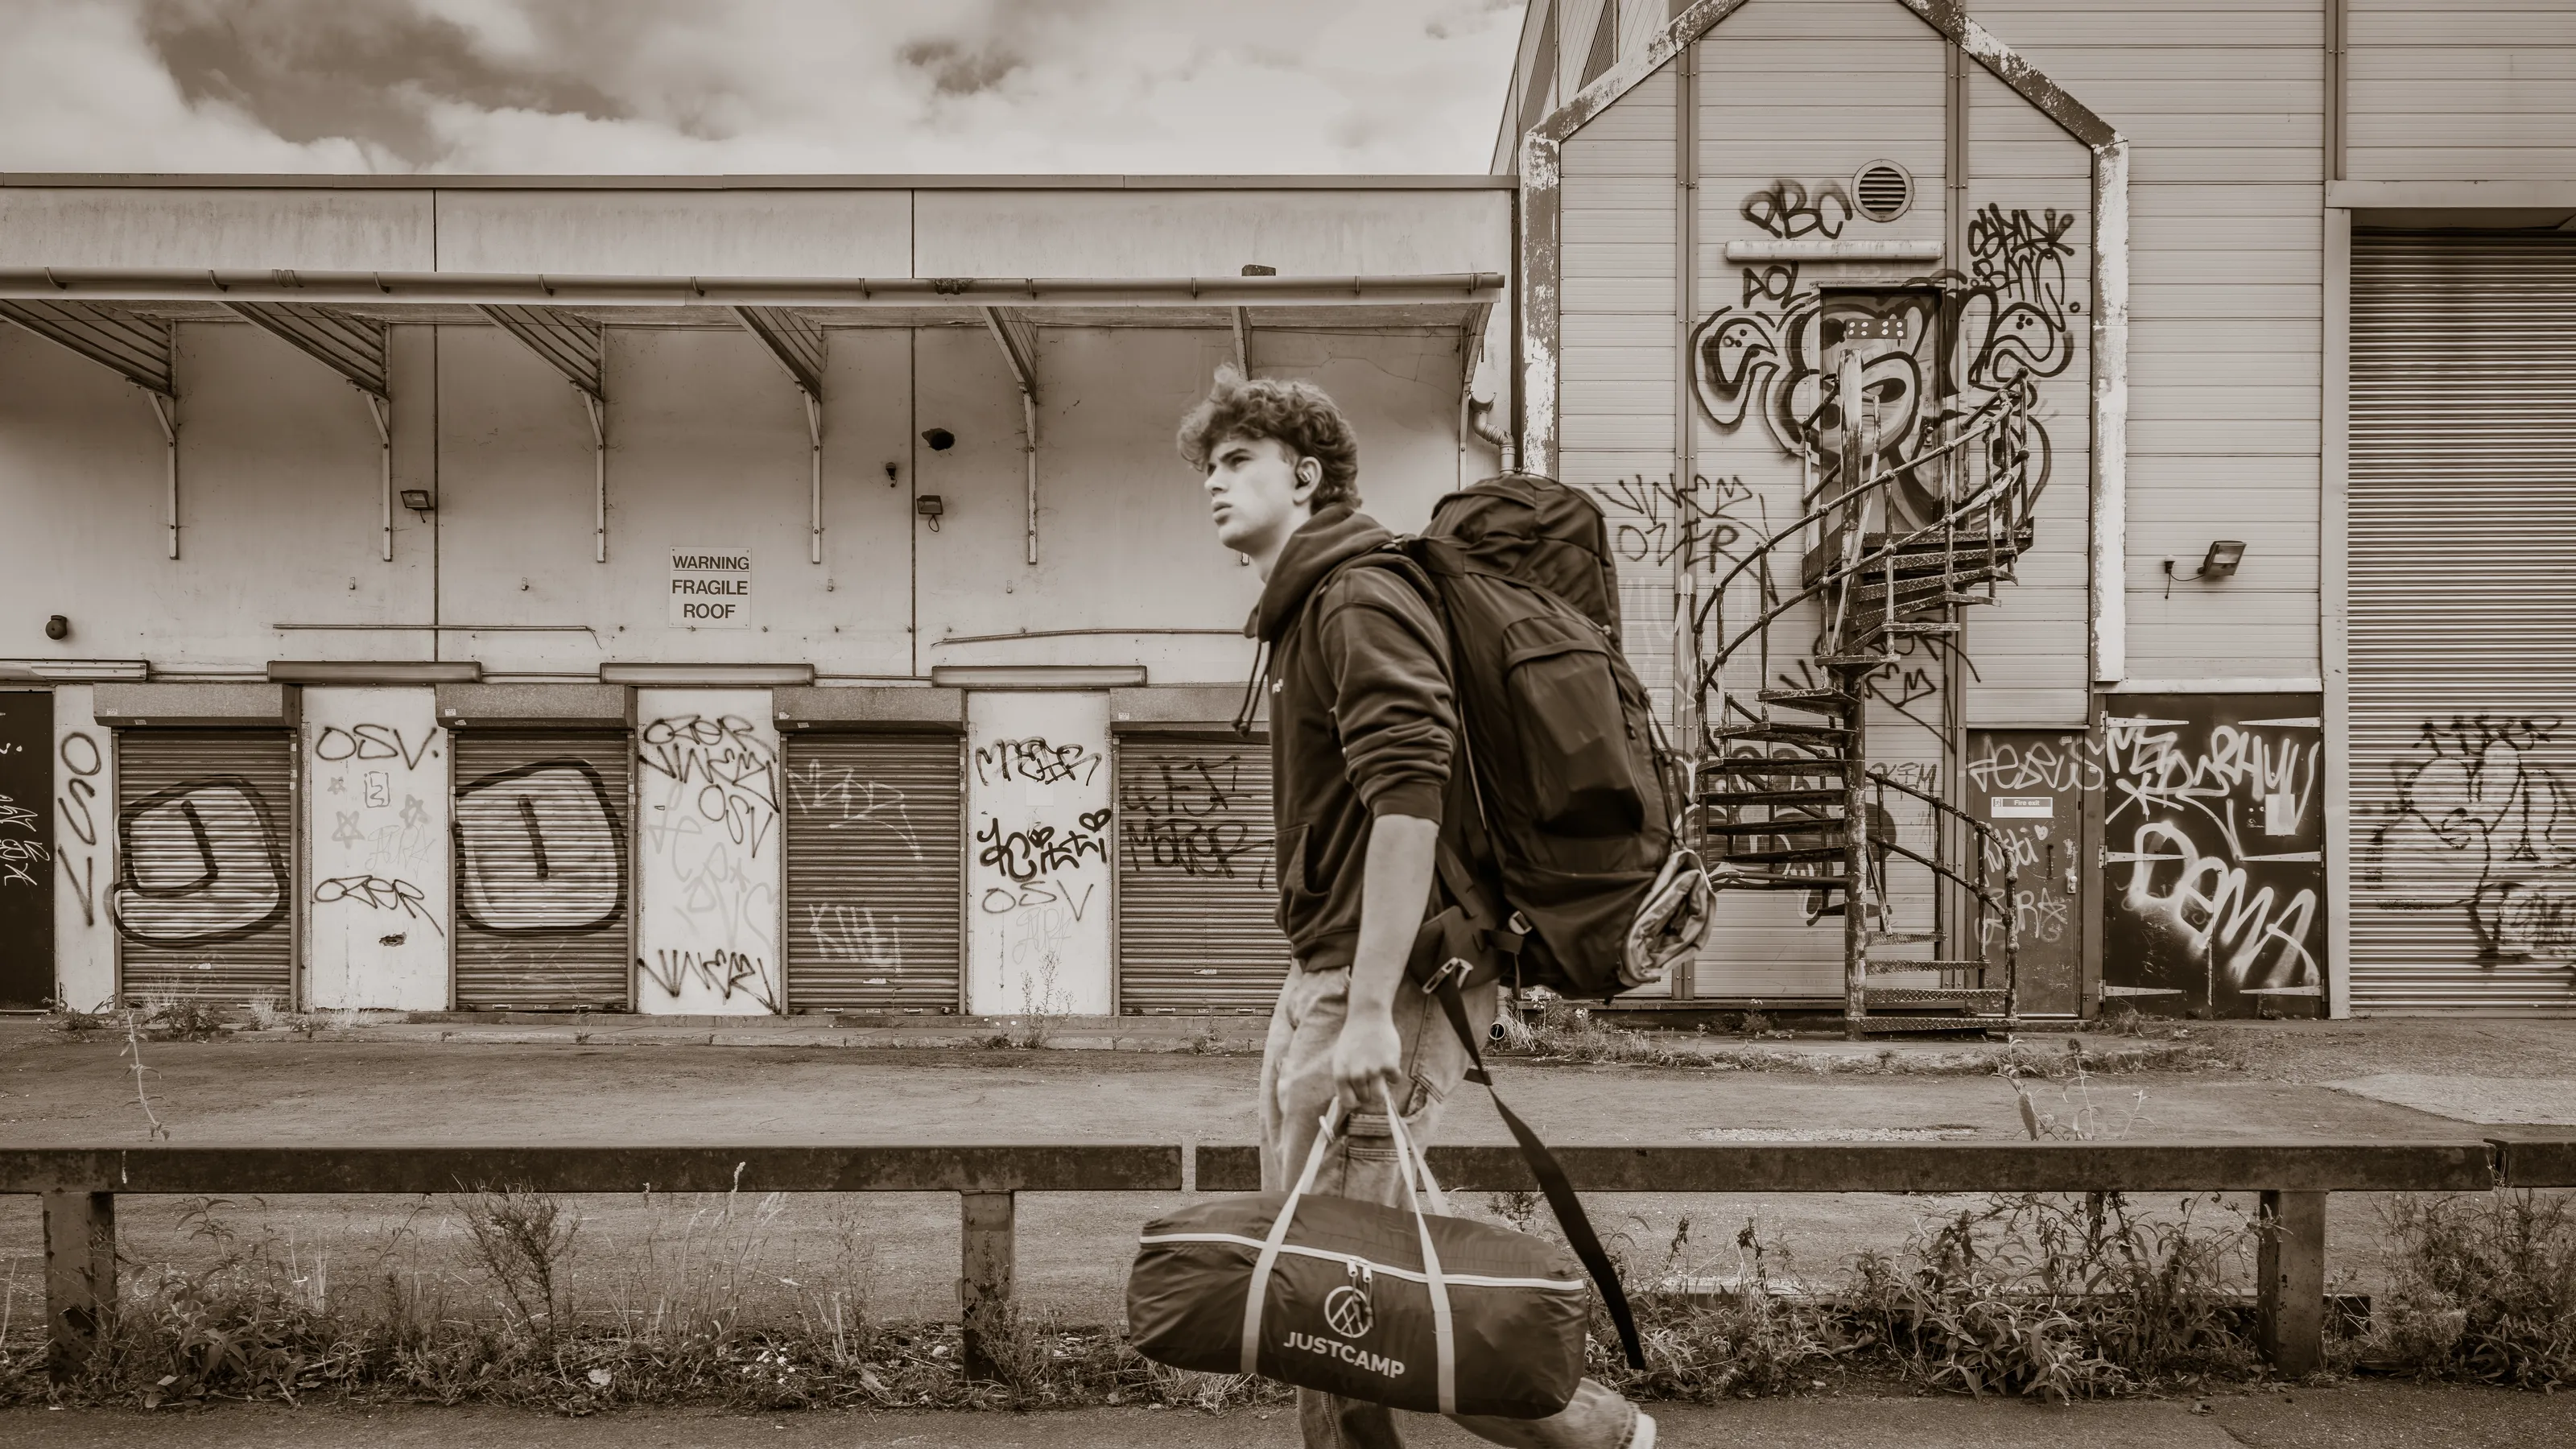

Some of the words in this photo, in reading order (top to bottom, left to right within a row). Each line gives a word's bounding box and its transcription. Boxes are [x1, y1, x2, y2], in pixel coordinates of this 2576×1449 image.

[672, 555, 749, 570] WARNING
[671, 580, 748, 595] FRAGILE
[683, 603, 736, 619] ROOF
[1283, 1331, 1406, 1379] JUSTCAMP
